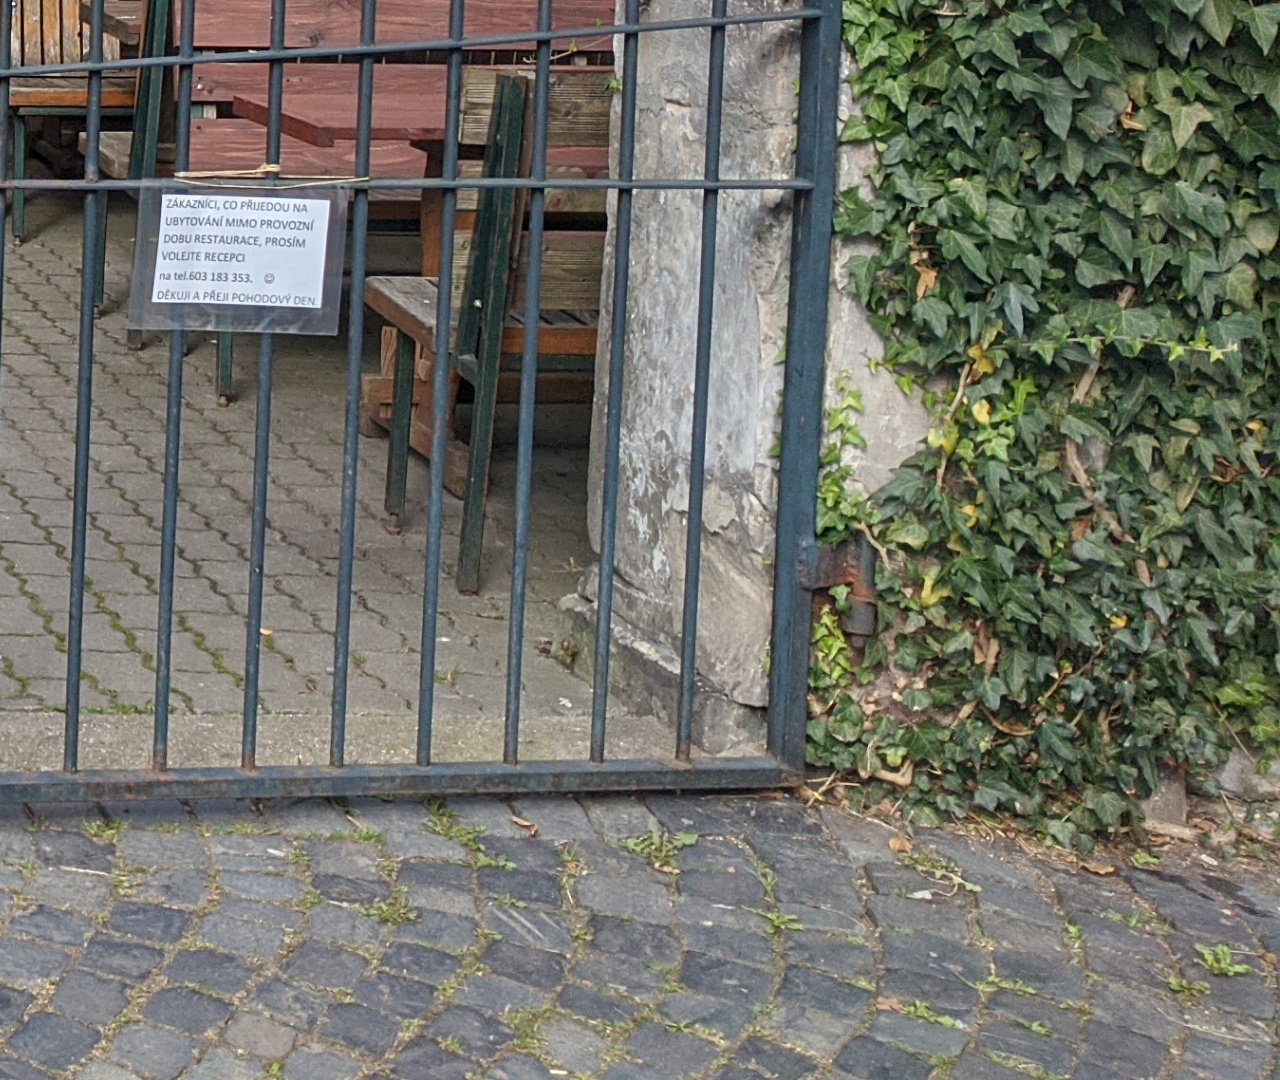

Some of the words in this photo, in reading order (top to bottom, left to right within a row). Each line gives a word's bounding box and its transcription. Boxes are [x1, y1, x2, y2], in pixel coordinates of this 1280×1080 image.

[166, 198, 220, 211] ZÁKAZNÍCI,
[223, 201, 237, 210] CO
[240, 200, 289, 213] PŘIJEDOU
[293, 204, 308, 213] NA
[165, 216, 223, 227] UBYTOVÁNÍ
[225, 219, 257, 228] MIMO
[260, 219, 314, 231] PROVOZNÍ
[164, 234, 192, 244] DOBU
[194, 235, 262, 247] RESTAURACE,
[265, 237, 306, 248] PROSÍM
[162, 252, 201, 261] VOLEJTE
[204, 253, 245, 262] RECEPCI
[159, 273, 171, 281] na
[211, 273, 228, 282] 183
[232, 274, 252, 283] 353.
[157, 289, 190, 300] DĚKUJI
[193, 292, 200, 300] A
[203, 291, 229, 302] PŘEJI
[232, 293, 291, 305] POHODOVÝ
[294, 296, 318, 306] DEN.
